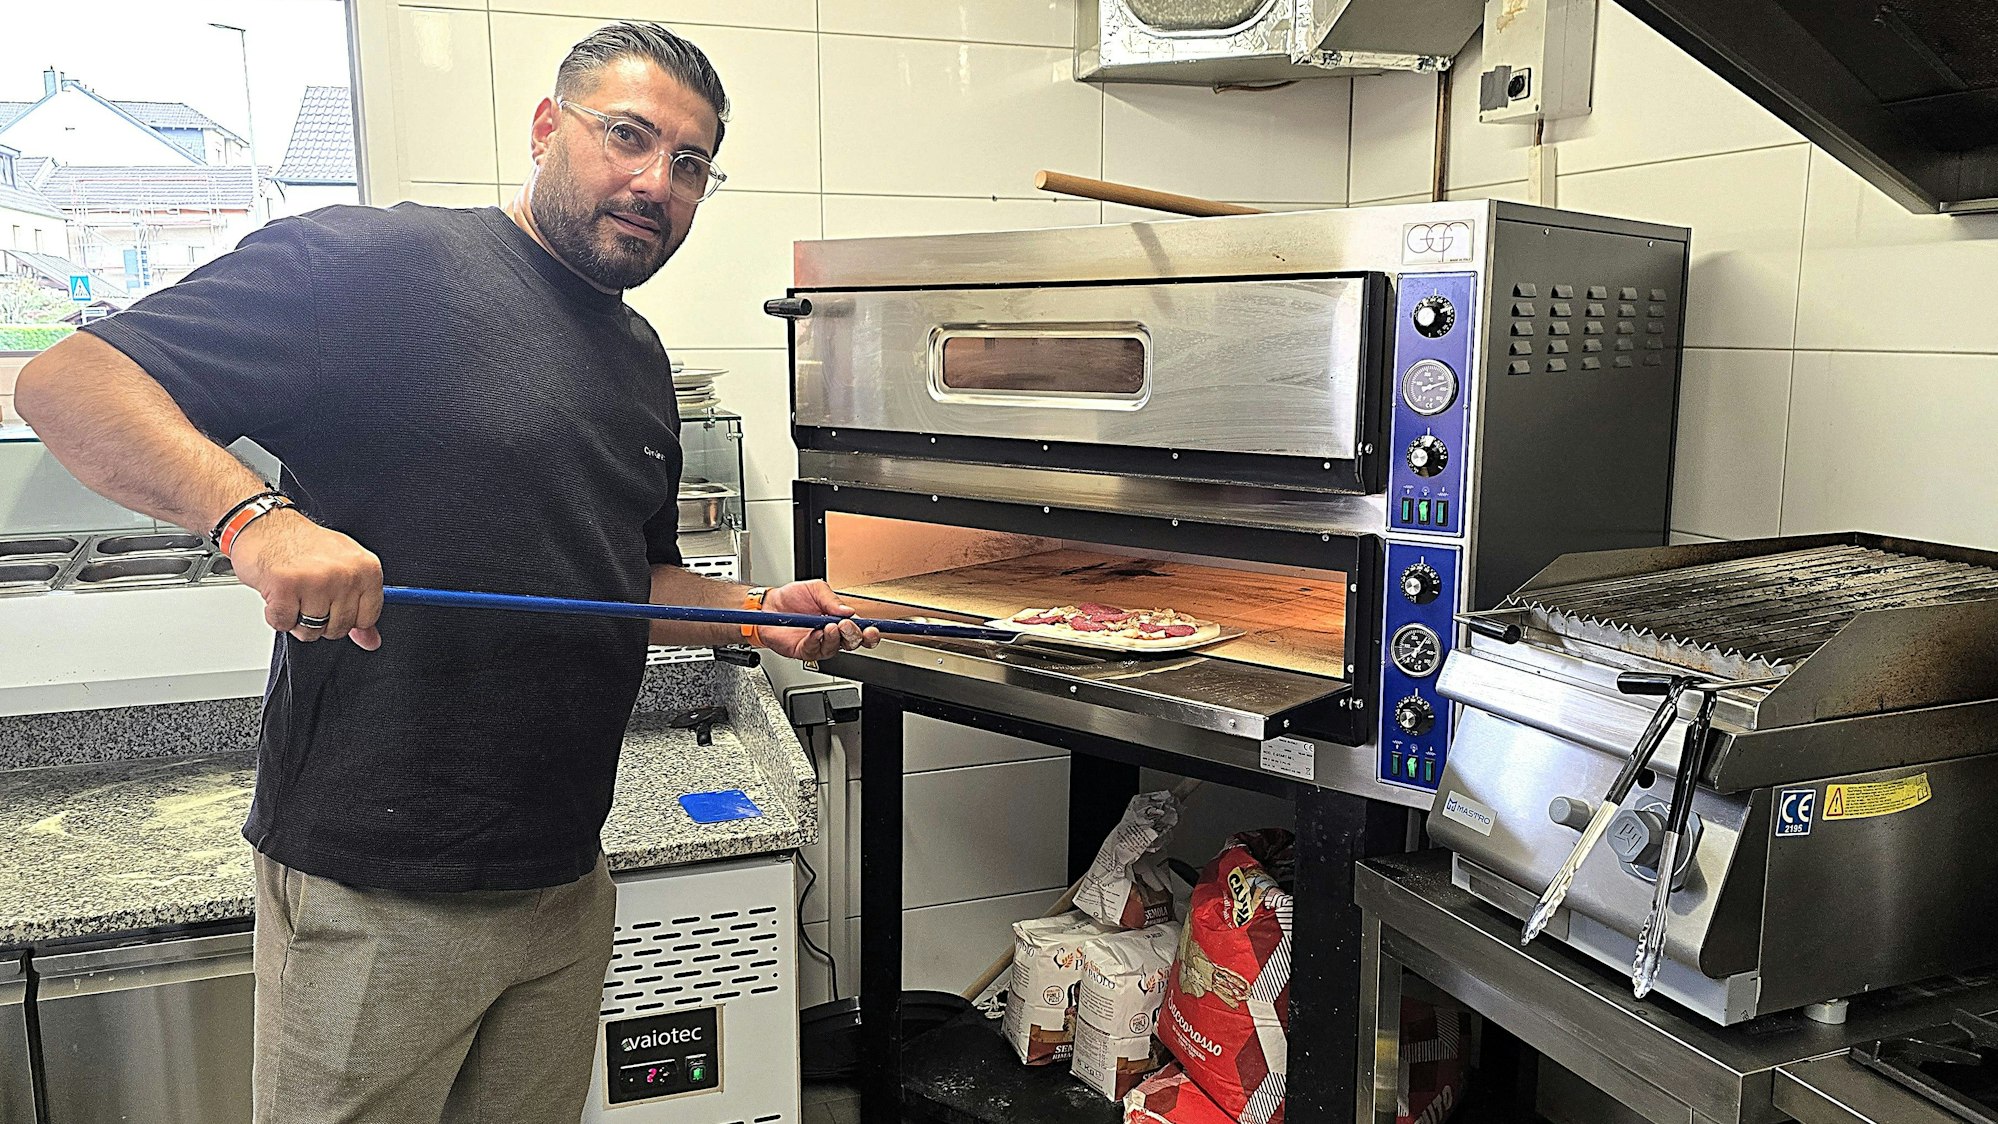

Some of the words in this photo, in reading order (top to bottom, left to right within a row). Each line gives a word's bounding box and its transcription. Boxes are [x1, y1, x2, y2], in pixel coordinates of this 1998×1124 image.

[1456, 804, 1491, 825] MASTRO
[1781, 793, 1814, 823] CE
[1784, 824, 1803, 833] 2195
[1168, 989, 1222, 1056] Saccorosso
[629, 1027, 702, 1050] vaiotec
